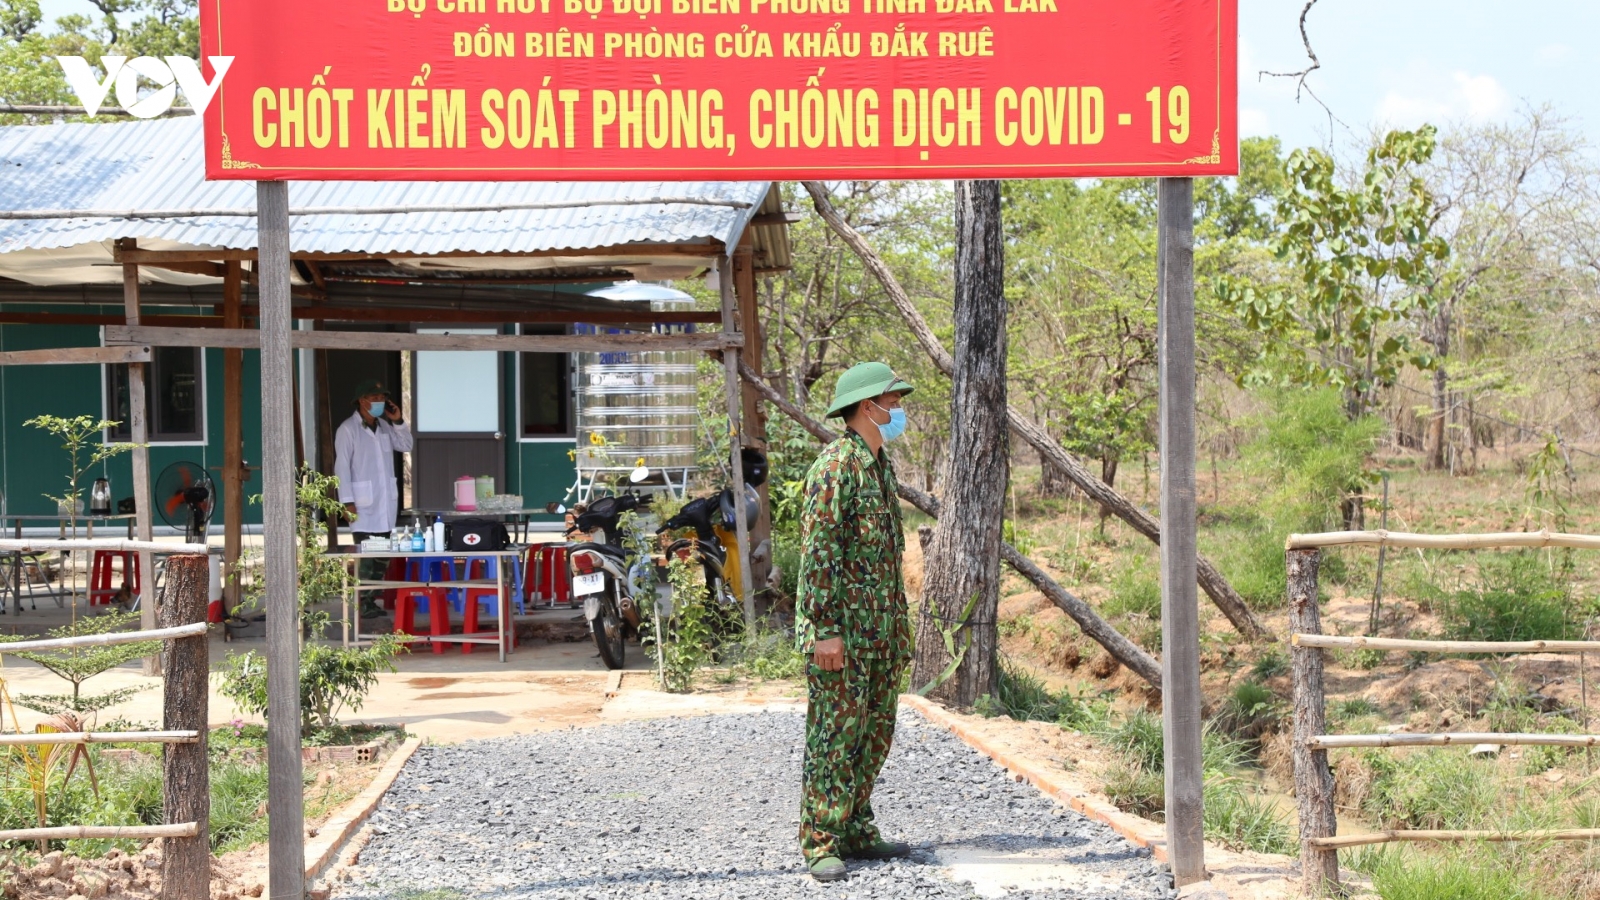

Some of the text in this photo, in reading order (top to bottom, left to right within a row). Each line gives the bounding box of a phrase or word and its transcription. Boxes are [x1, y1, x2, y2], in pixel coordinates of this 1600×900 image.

[452, 22, 994, 58] ĐỒN BIÊN PHÒNG CỬA KHẨU ĐẮK RUÊ
[252, 66, 354, 149] CHỐT
[367, 63, 467, 149] KIỂM
[480, 76, 580, 149] SOÁT
[593, 74, 736, 157] PHÒNG,
[749, 67, 880, 149] CHỐNG
[893, 87, 982, 161] DỊCH
[995, 86, 1105, 147] COVID
[1145, 85, 1191, 145] 19
